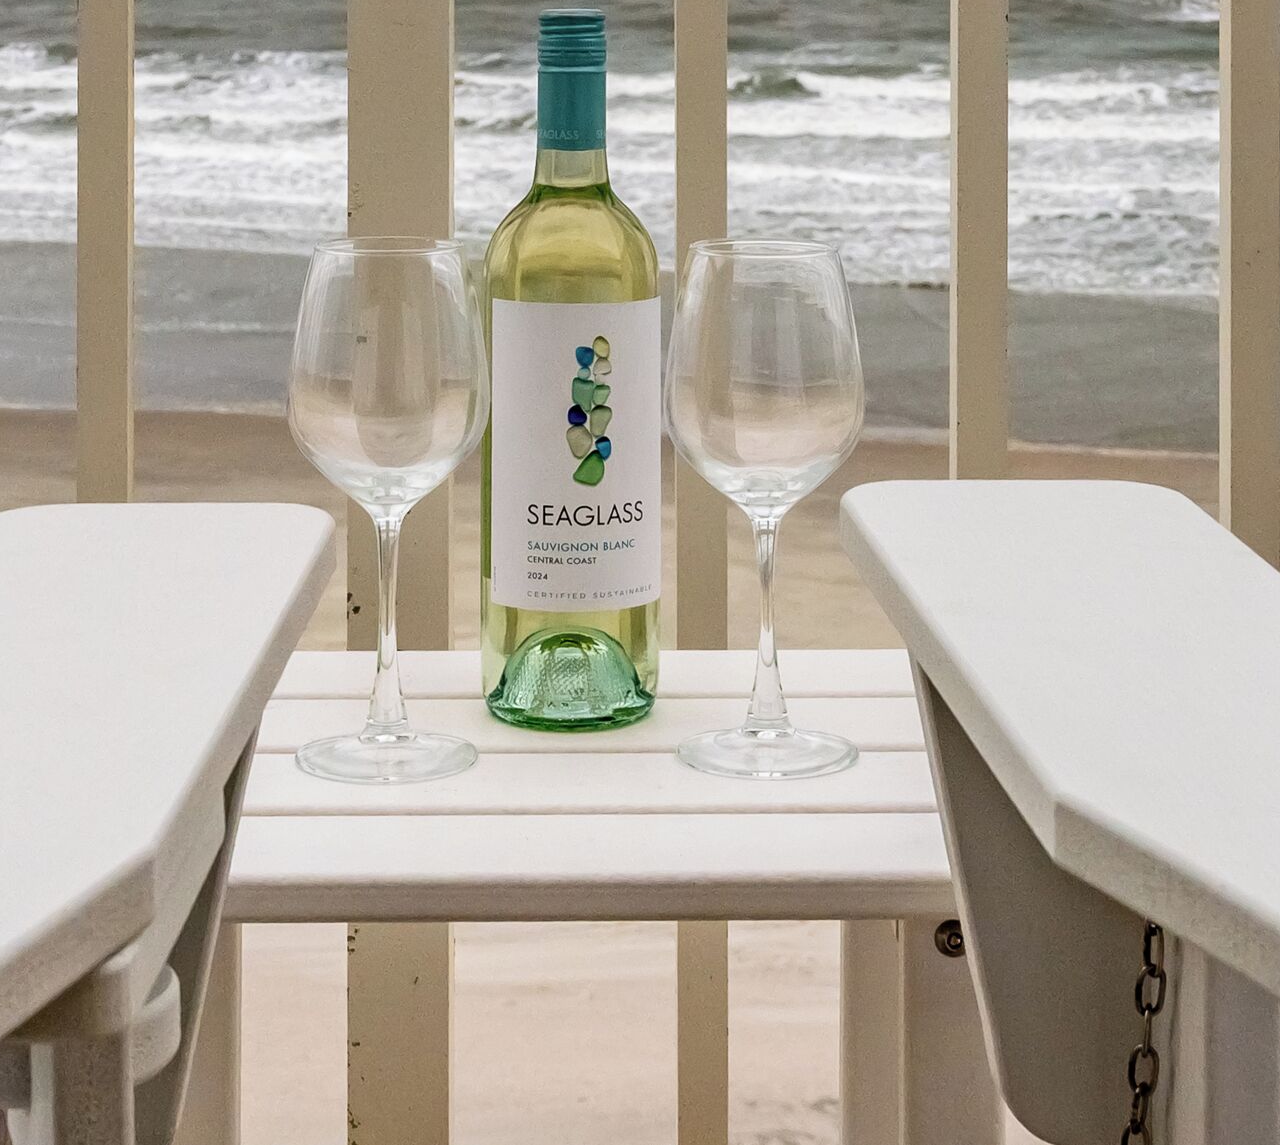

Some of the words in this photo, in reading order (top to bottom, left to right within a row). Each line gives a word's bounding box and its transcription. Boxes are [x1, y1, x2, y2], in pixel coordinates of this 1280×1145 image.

[527, 500, 644, 527] SEAGLASS
[527, 540, 599, 552] SAUVIGNON
[603, 538, 636, 552] BLANC
[527, 555, 564, 565] CENTRAL
[566, 556, 597, 565] COAST
[527, 571, 548, 581] 2024
[527, 590, 586, 600] CERTIFIED
